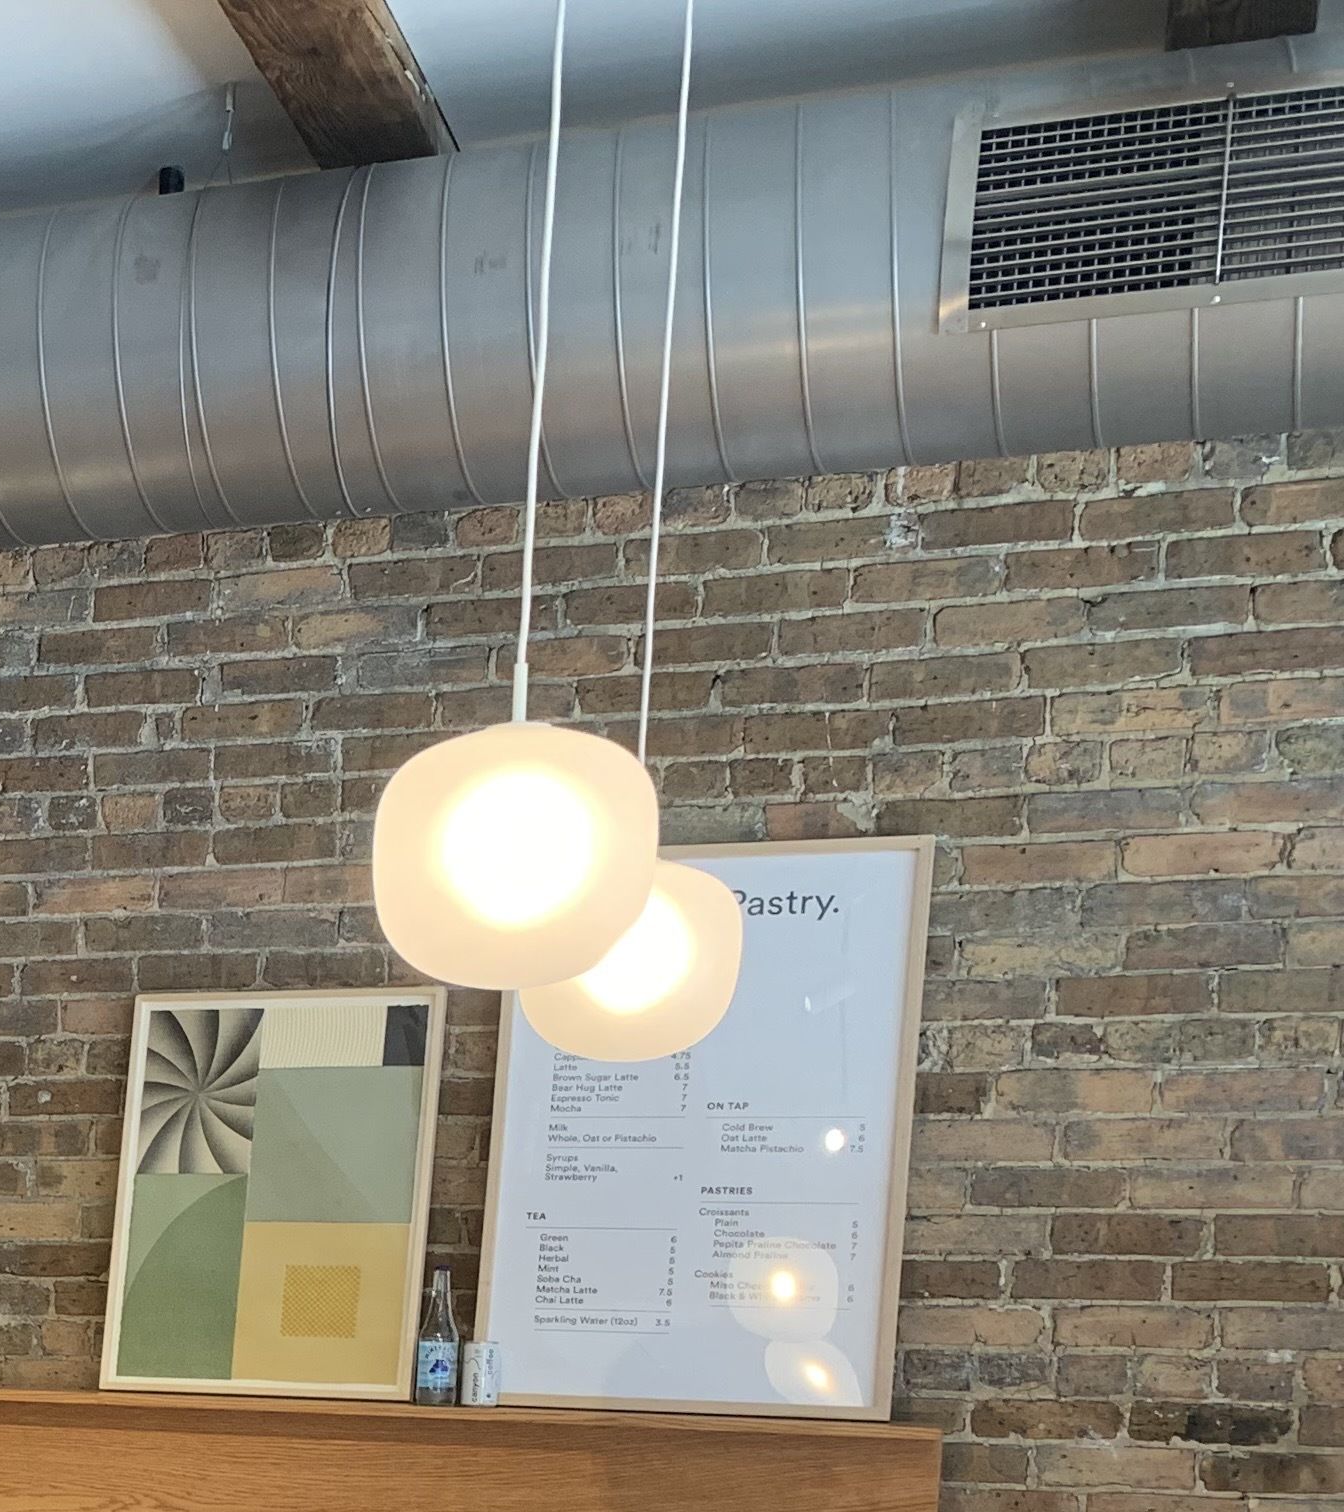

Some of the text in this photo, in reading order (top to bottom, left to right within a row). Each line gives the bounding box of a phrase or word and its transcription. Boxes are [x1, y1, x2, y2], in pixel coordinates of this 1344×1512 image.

[553, 1063, 578, 1071] Latte
[552, 1073, 639, 1083] Brown Sugar Latte
[673, 1073, 690, 1081] 6.5
[551, 1084, 623, 1093] Bear Hug Latte
[681, 1083, 688, 1091] 7
[550, 1094, 620, 1103] Espresso Tonic
[550, 1104, 582, 1112] Mocha
[680, 1104, 687, 1112] 7
[707, 1102, 750, 1110] ON TAP
[721, 1123, 774, 1132] Cold Brew
[547, 1134, 581, 1142] Whole,
[582, 1134, 600, 1142] Oat
[614, 1134, 657, 1142] Pistachio
[721, 1134, 768, 1142] Oat Latte
[720, 1145, 804, 1153] Matcha Pistachio
[849, 1145, 864, 1153] 7.5
[546, 1154, 578, 1163] Syrups
[545, 1164, 618, 1173] Simple, Vanilla,
[544, 1173, 598, 1182] Strawberry
[700, 1187, 753, 1195] PASTRIES
[526, 1212, 547, 1220] TEA
[698, 1208, 750, 1217] Croissants
[714, 1218, 739, 1227] Plain
[851, 1221, 859, 1229] 5
[713, 1229, 765, 1238] Chocolate
[851, 1231, 858, 1239] 6
[539, 1234, 569, 1242] Green
[670, 1236, 677, 1244] 6
[539, 1244, 564, 1252] Black
[713, 1240, 837, 1250] Pepita Praline Chocolate
[851, 1242, 857, 1250] 7
[538, 1254, 569, 1262] Herbal
[712, 1250, 751, 1259] Almond
[850, 1253, 856, 1261] 7
[537, 1265, 559, 1273] Mint
[694, 1270, 734, 1279] Cookies
[537, 1275, 582, 1284] Soba Cha
[709, 1281, 734, 1290] Miso
[536, 1286, 598, 1294] Matcha Latte
[658, 1288, 673, 1296] 7.5
[535, 1296, 584, 1304] Chai Latte
[709, 1292, 736, 1301] Black
[534, 1315, 638, 1327] Sparkling Water (12oz)
[655, 1319, 670, 1327] 3.5
[472, 1372, 480, 1403] canyon
